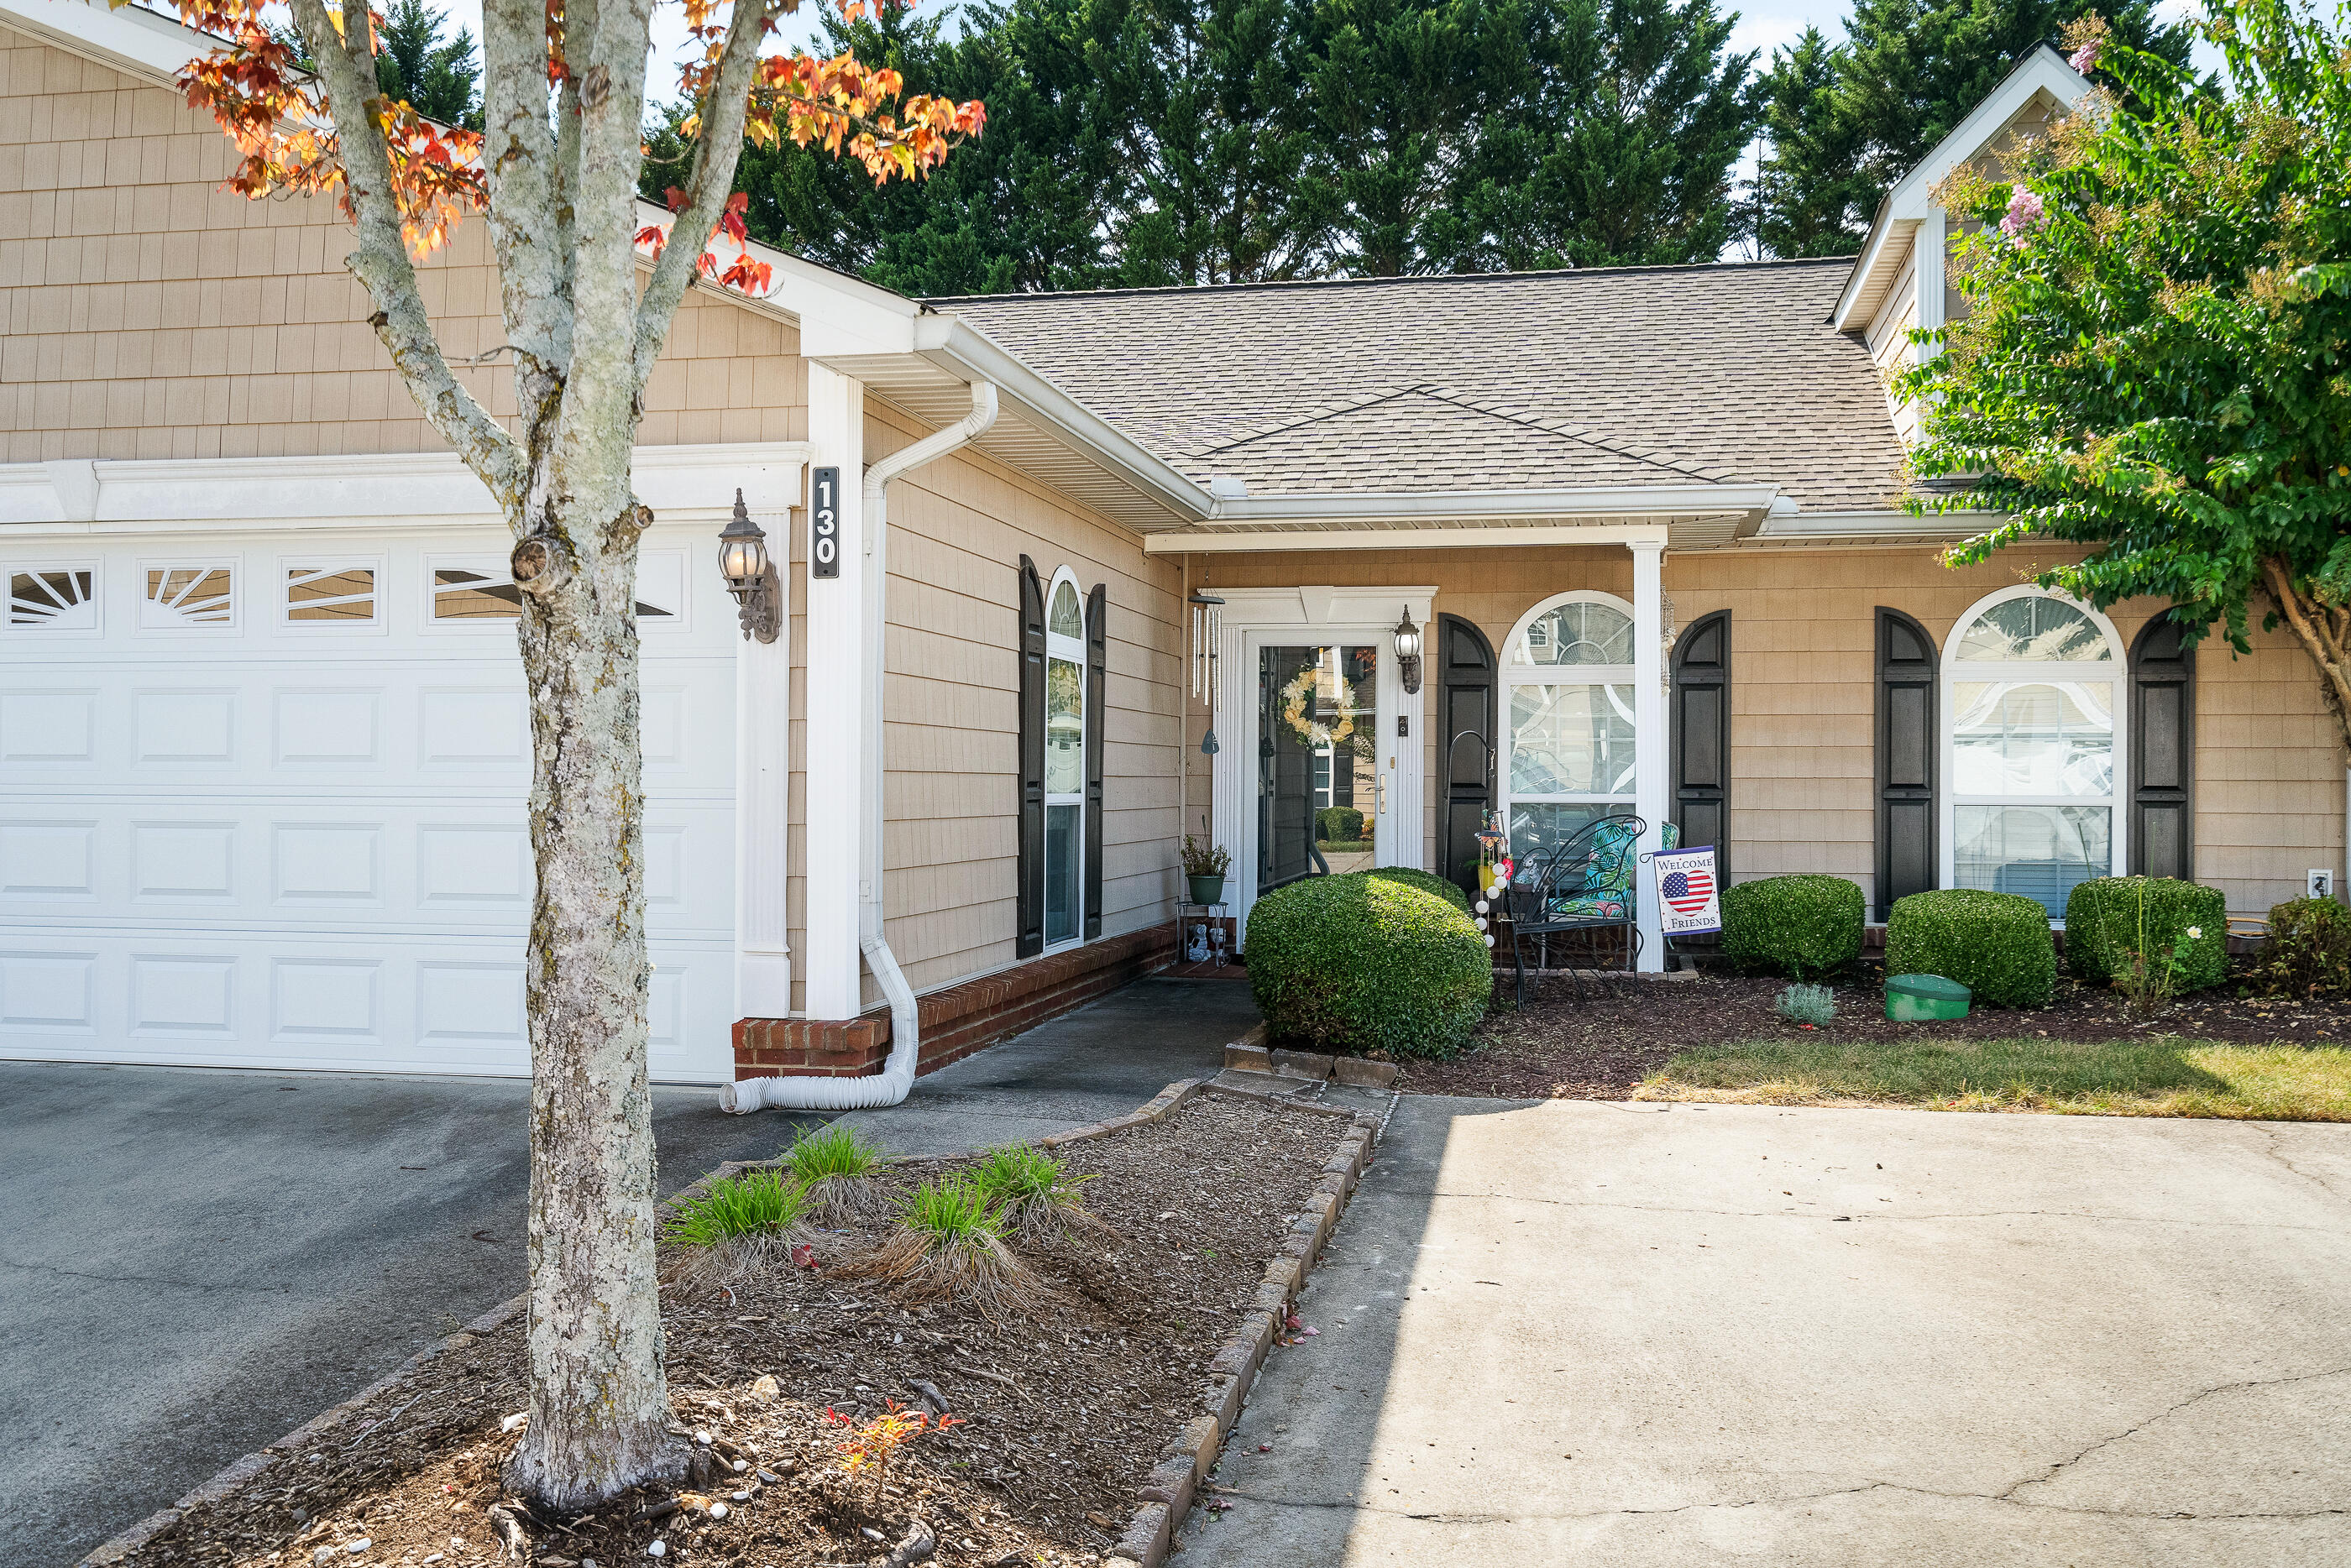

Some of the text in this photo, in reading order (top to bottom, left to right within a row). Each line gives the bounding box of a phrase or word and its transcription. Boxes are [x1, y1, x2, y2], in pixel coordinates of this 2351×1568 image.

[817, 482, 835, 563] 130
[1657, 858, 1713, 870] WELCOME
[1671, 917, 1716, 928] FRIENDS
